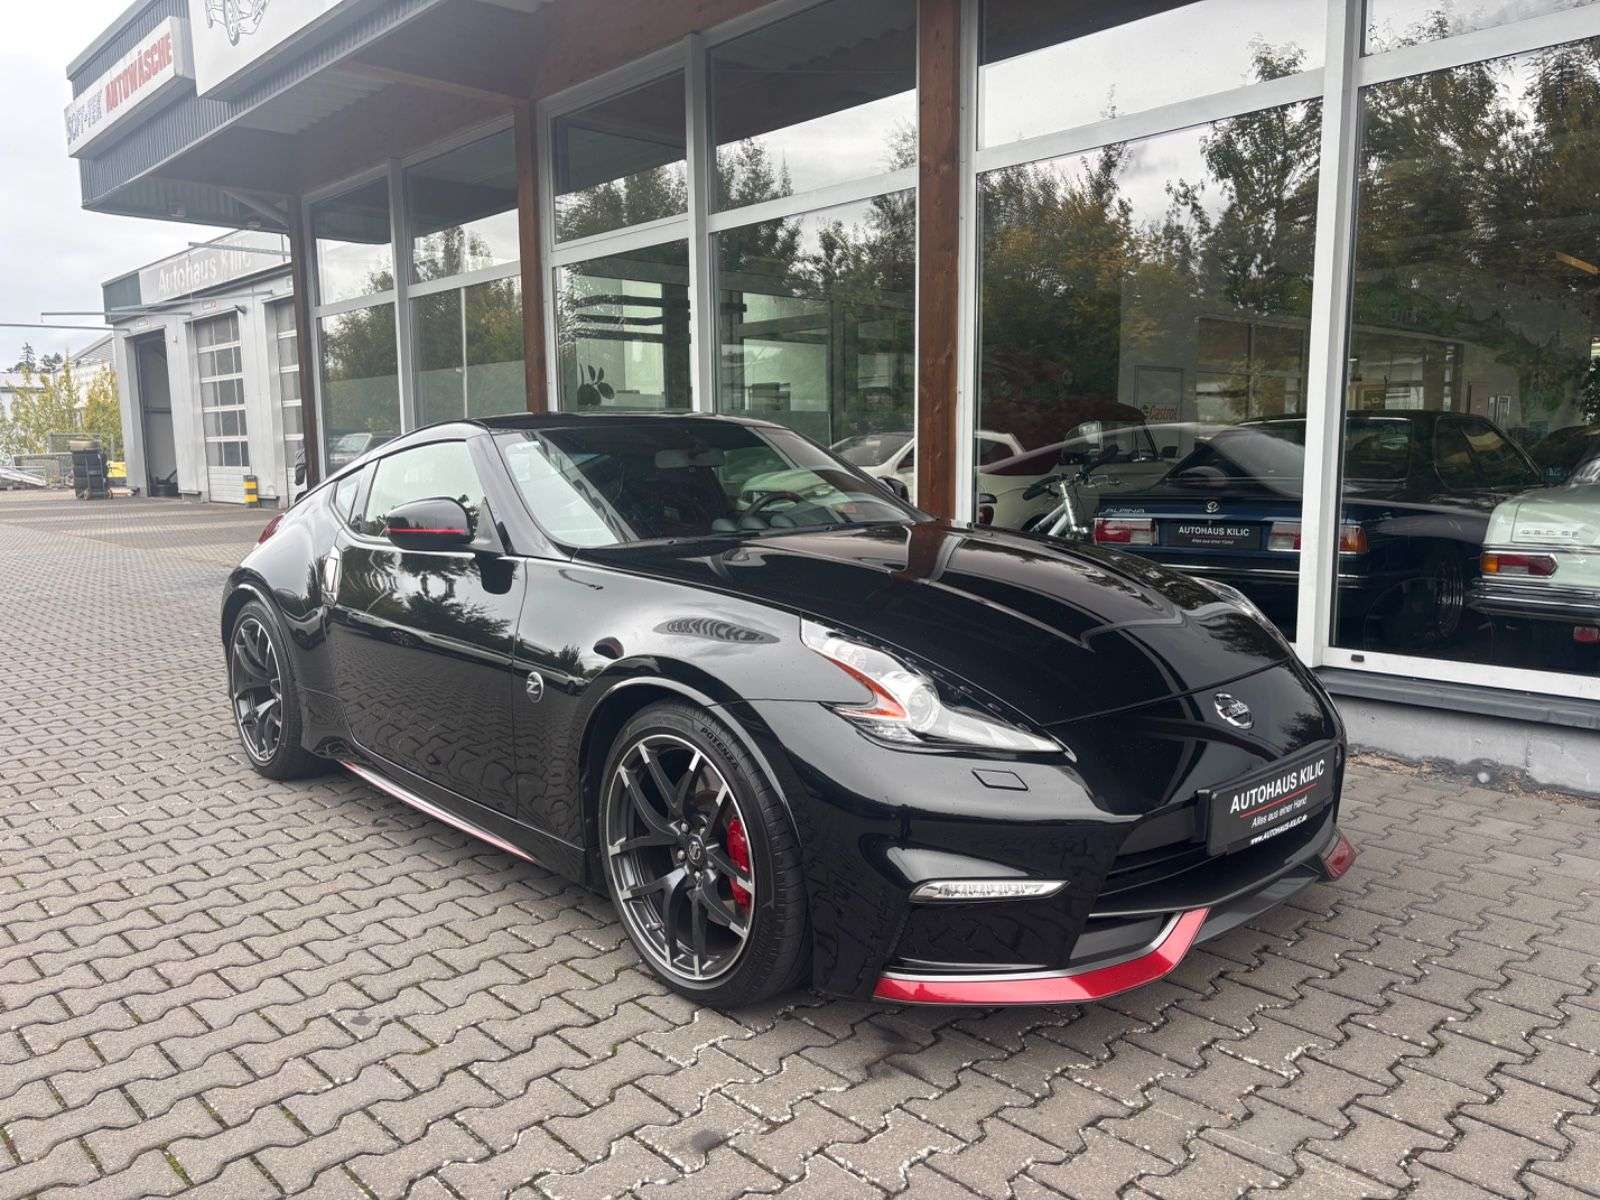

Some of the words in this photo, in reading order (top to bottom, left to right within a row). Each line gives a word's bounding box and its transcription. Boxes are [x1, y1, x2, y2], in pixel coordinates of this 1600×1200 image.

[105, 32, 173, 114] AUTOWÄSCHE
[159, 251, 217, 290] Autohaus
[1178, 525, 1225, 536] AUTOHAUS
[1226, 527, 1250, 537] KILIC
[700, 727, 741, 770] POTENZA
[1229, 772, 1298, 814] AUTOHAUS
[1299, 759, 1325, 786] KILIC
